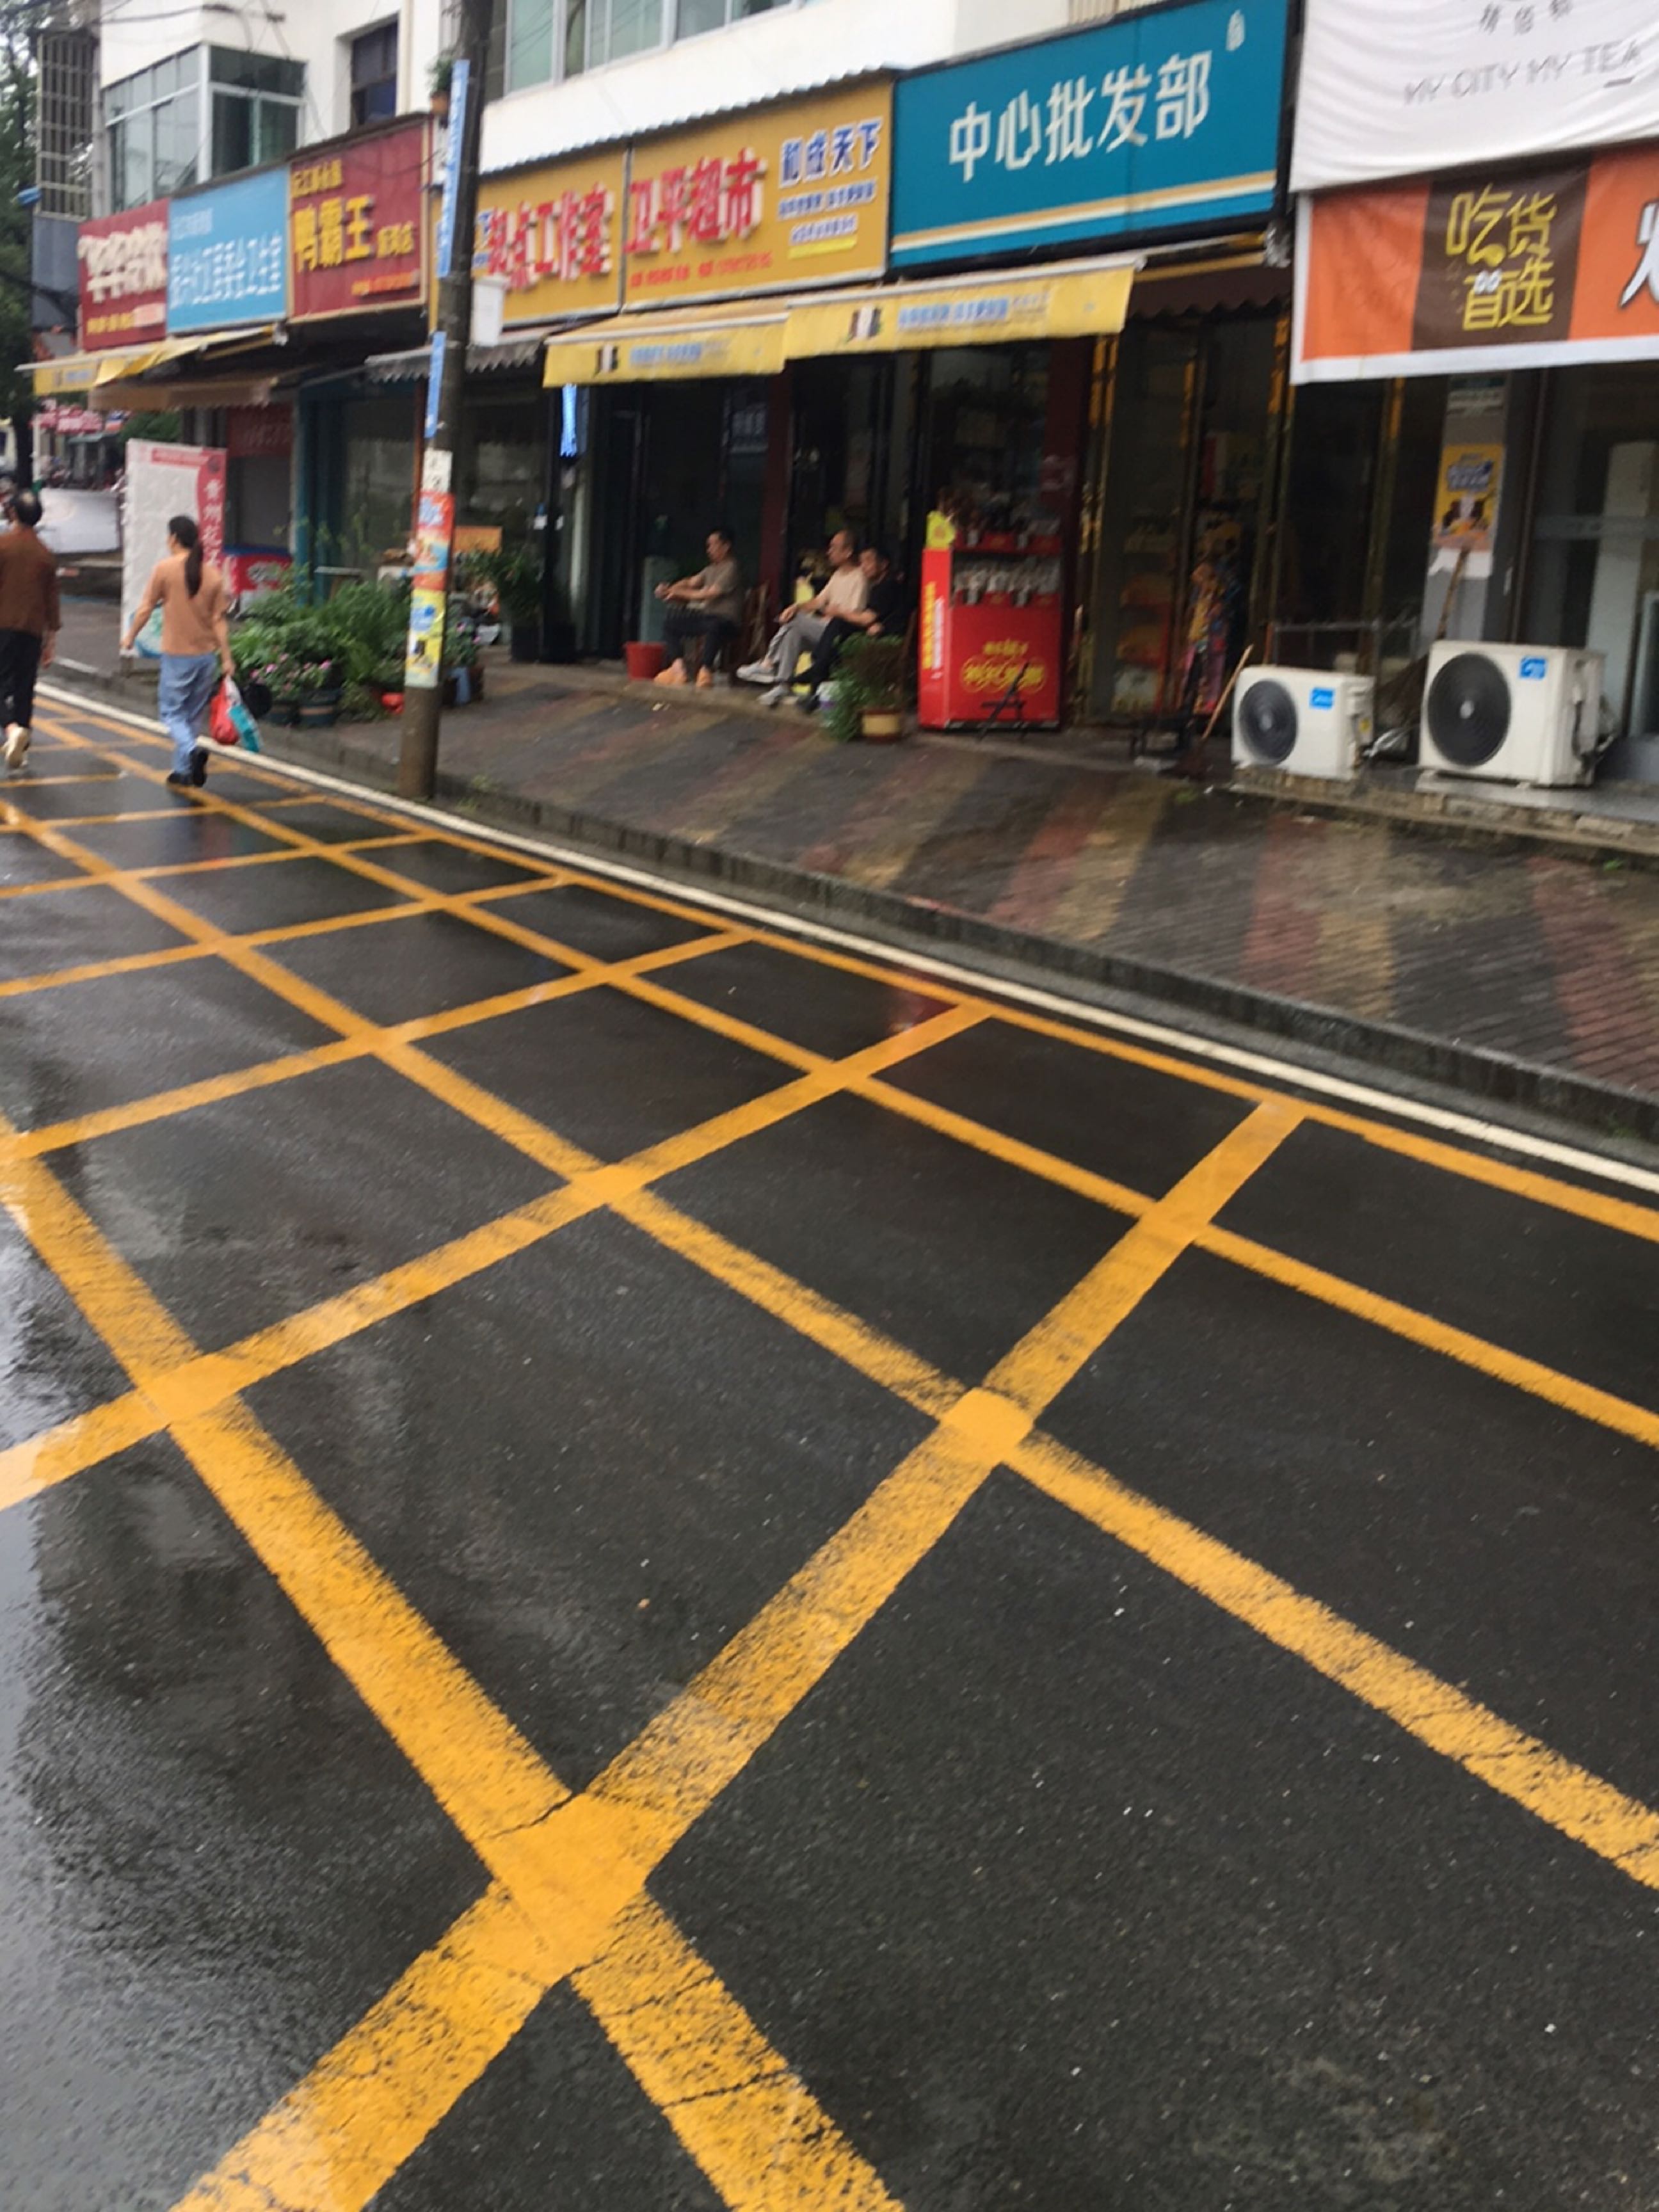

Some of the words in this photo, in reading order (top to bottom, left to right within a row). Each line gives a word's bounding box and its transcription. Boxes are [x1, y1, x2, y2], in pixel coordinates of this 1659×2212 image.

[1451, 62, 1521, 99] CITY
[1581, 38, 1642, 75] TEA
[949, 50, 1212, 183] 中心批发部
[294, 195, 373, 273] 鸭霸王
[623, 147, 767, 255] 卫平超市
[1445, 183, 1557, 266] 吃货
[1462, 253, 1553, 332] 首选
